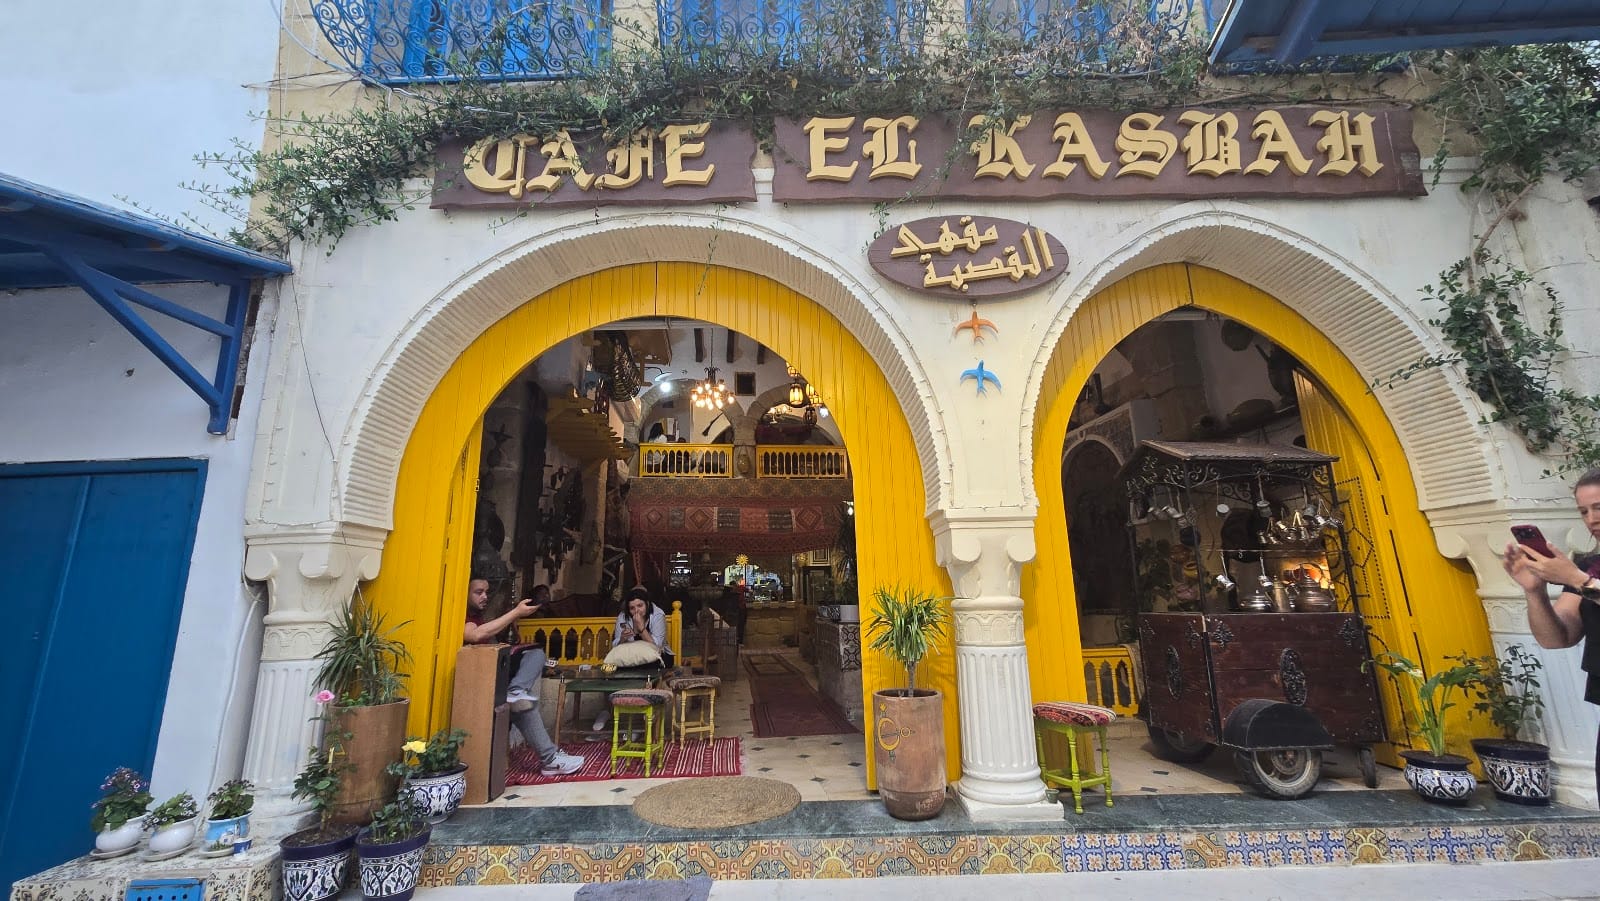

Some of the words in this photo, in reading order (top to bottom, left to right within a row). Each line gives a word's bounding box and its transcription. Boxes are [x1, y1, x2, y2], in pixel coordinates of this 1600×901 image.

[463, 121, 716, 199] CAFE
[803, 114, 923, 182] EL
[967, 109, 1385, 181] KASBAH
[919, 226, 1055, 293] القصبة
